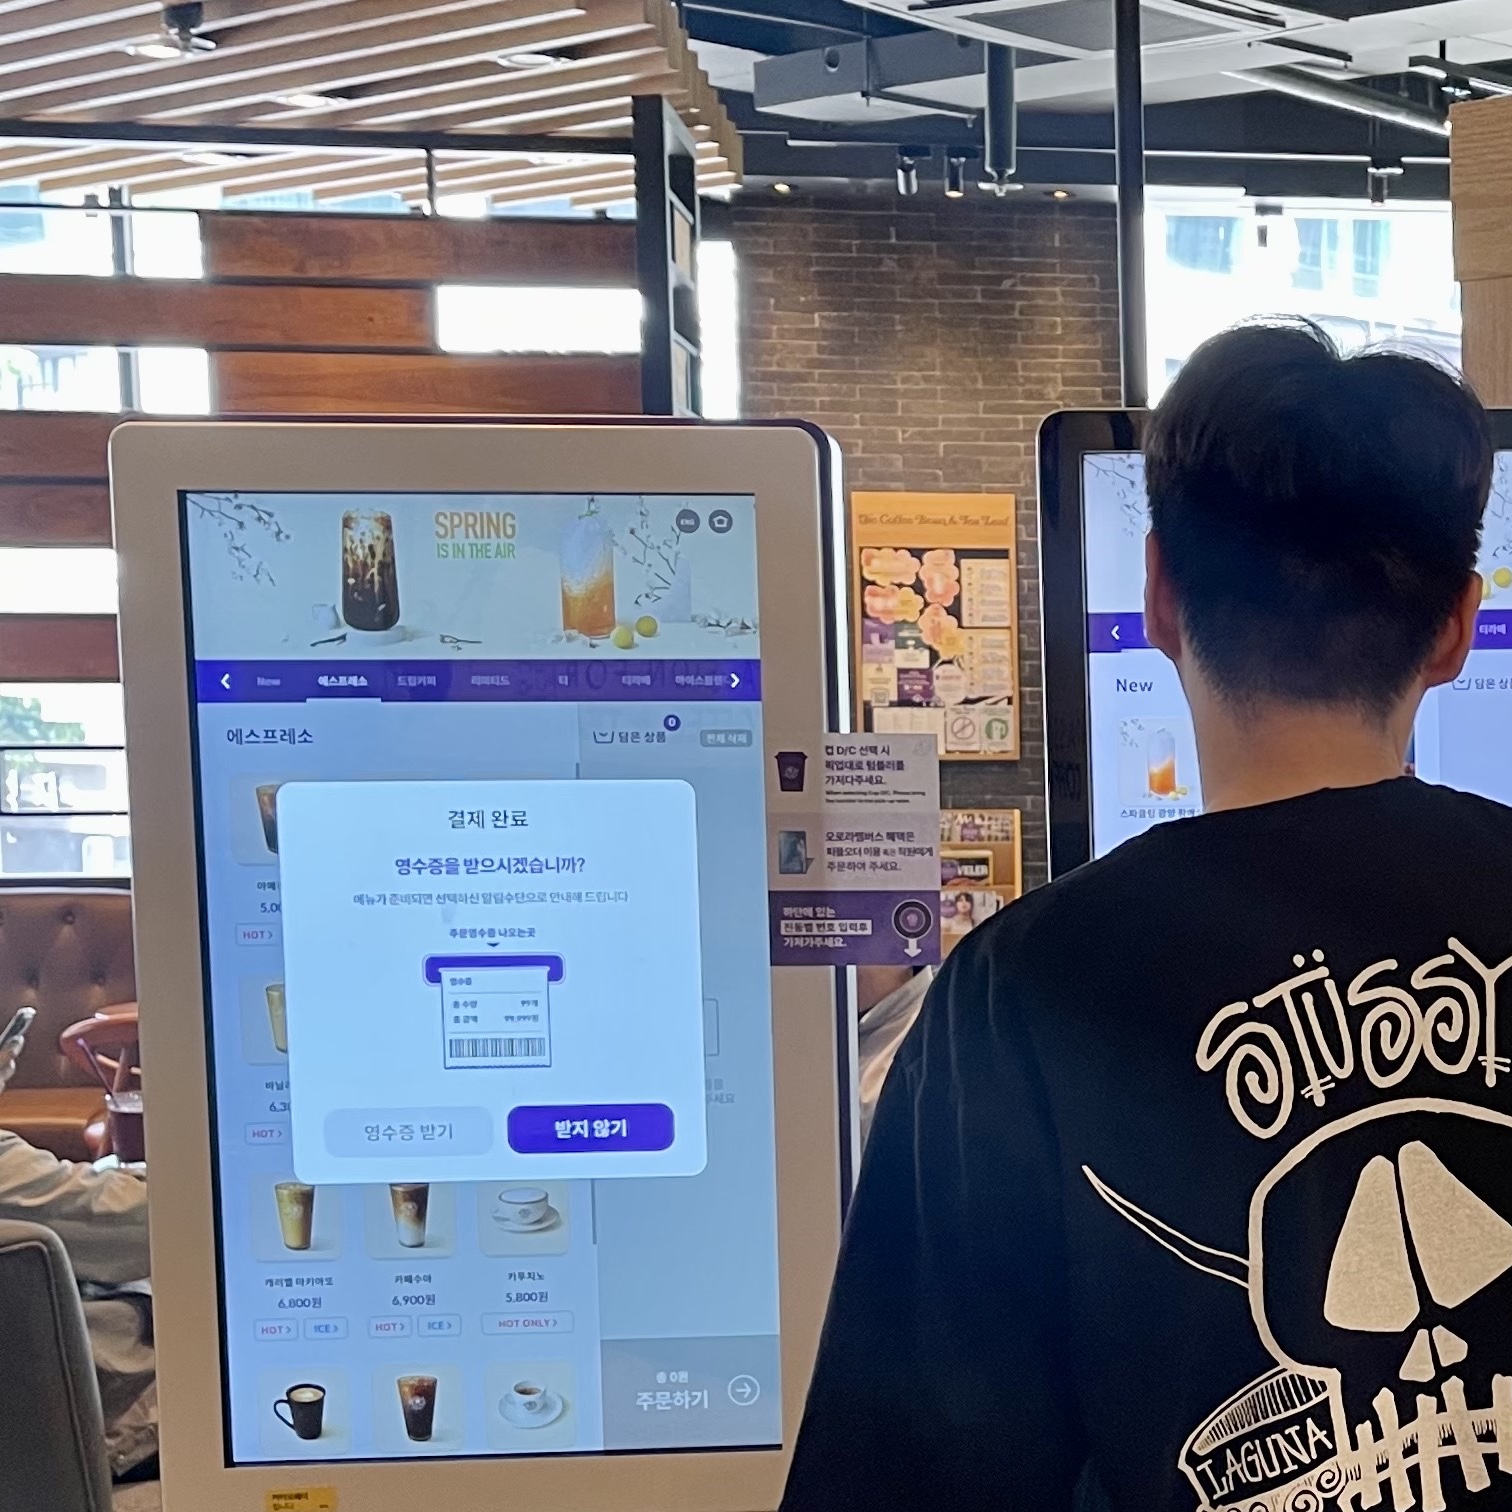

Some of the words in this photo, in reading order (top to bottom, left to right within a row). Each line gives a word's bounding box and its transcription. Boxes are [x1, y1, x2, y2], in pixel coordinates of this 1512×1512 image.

[434, 511, 516, 540] SPRING
[880, 514, 913, 525] Coffee
[437, 543, 449, 559] IS
[452, 543, 466, 559] IN
[469, 543, 491, 559] THE
[494, 543, 516, 559] AIR
[318, 675, 368, 687] 에스프레소
[1116, 678, 1153, 693] New
[668, 717, 676, 727] 0
[226, 728, 314, 745] 에스프레소
[618, 731, 640, 743] 담은
[643, 731, 666, 743] 상품
[825, 745, 834, 755] 컵
[836, 745, 856, 755] D/C
[858, 745, 878, 755] 선택
[881, 745, 890, 755] 시
[825, 760, 864, 771] 픽업대로
[825, 775, 887, 786] 가져다주세요.
[448, 810, 486, 829] 결제
[491, 810, 528, 828] 완료
[395, 857, 460, 875] 영수증을
[463, 856, 585, 875] 받으시겠습니까?
[827, 861, 866, 872] 주문하여
[869, 861, 902, 871] 주세요.
[353, 894, 387, 906] 메뉴가
[389, 893, 433, 905] 준비되면
[435, 893, 480, 905] 선택하신
[481, 892, 547, 904] 알림수단으로
[550, 892, 582, 903] 안내해
[585, 891, 628, 903] 드립니다
[815, 906, 836, 918] 있는
[498, 927, 536, 938] 나오는곳
[816, 922, 836, 932] 번호
[243, 931, 266, 940] HOT
[252, 1130, 275, 1139] HOT
[364, 1124, 415, 1142] 영수증
[420, 1123, 453, 1141] 받기
[554, 1119, 588, 1139] 받지
[593, 1118, 628, 1138] 않기
[277, 1296, 322, 1309] 6,800원
[391, 1293, 436, 1306] 6,900원
[505, 1291, 549, 1303] 5,800원
[314, 1324, 330, 1334] ICE
[375, 1322, 397, 1332] HOT
[427, 1321, 444, 1331] ICE
[498, 1319, 521, 1329] HOT
[522, 1318, 550, 1328] ONLY
[261, 1325, 283, 1335] HOT
[669, 1371, 689, 1384] 0원
[636, 1390, 709, 1411] 주문하기
[1196, 1417, 1334, 1501] LAGUNA
